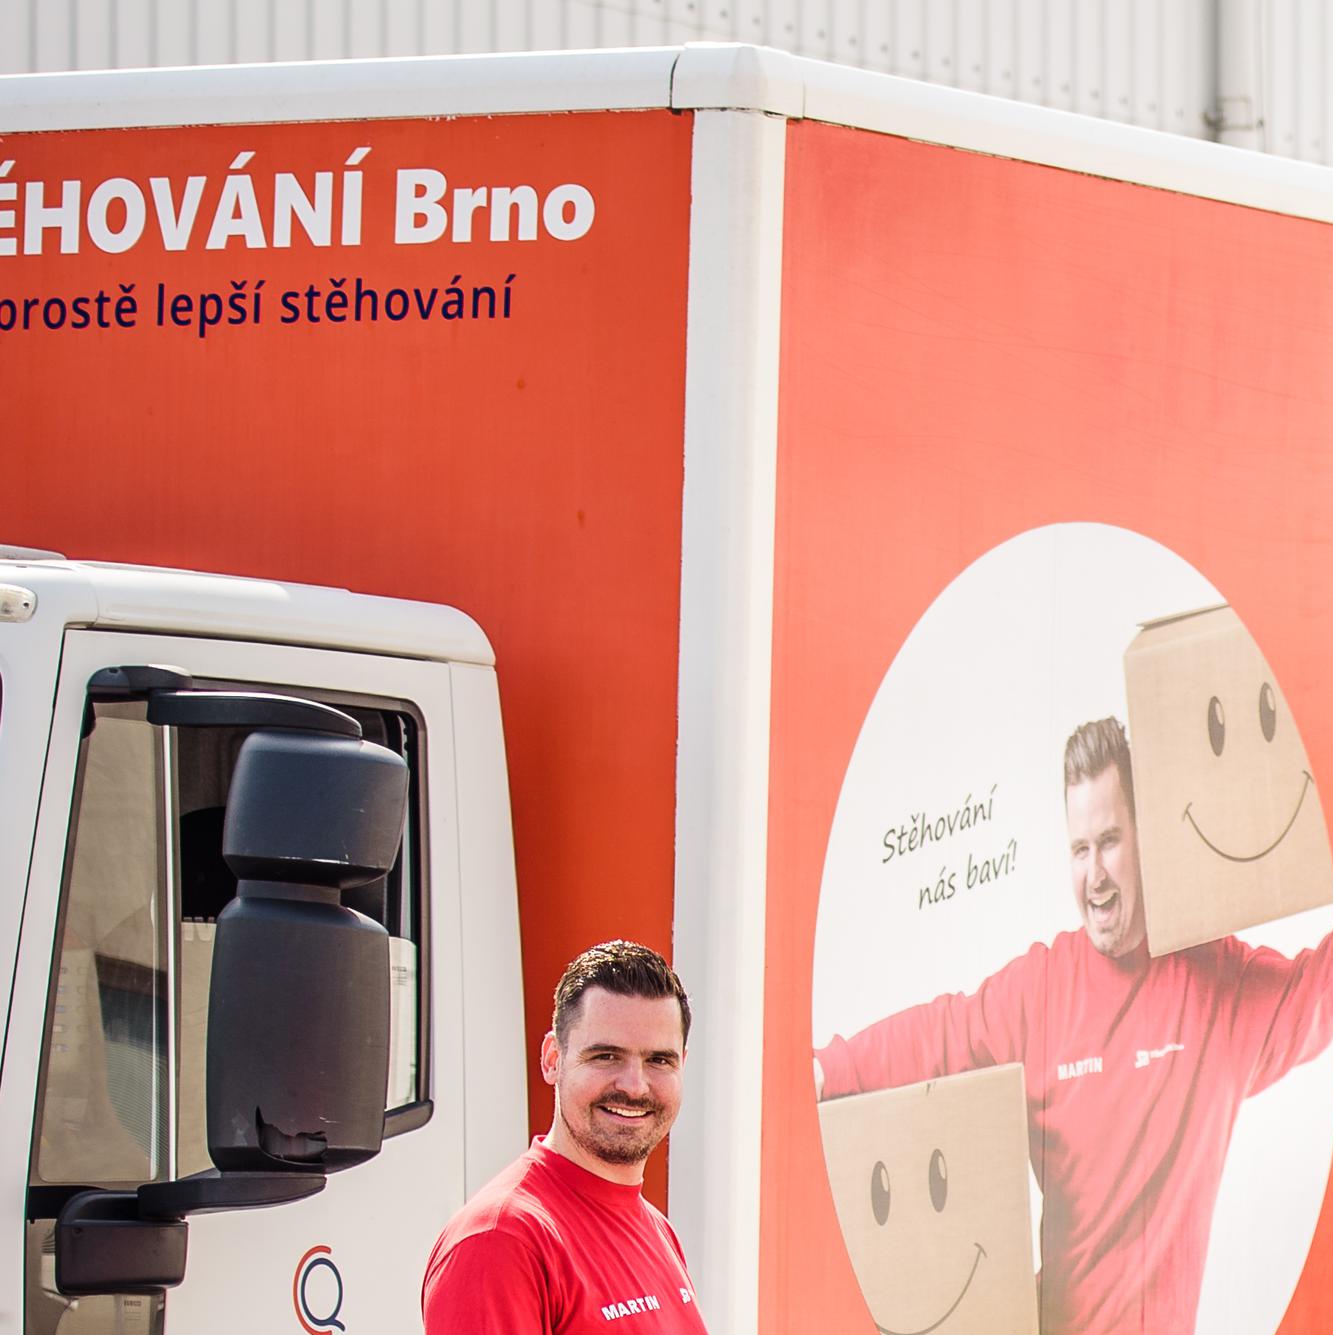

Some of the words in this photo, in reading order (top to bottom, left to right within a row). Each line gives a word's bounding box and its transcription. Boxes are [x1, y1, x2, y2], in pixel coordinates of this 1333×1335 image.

[394, 168, 595, 244] Brno
[157, 279, 266, 338] lepší
[280, 274, 517, 325] stěhování
[883, 784, 997, 863] Stěhování
[919, 865, 956, 910] nás
[967, 838, 1017, 889] baví!
[1057, 1057, 1102, 1080] MARTIN
[601, 1295, 660, 1321] MARTIN
